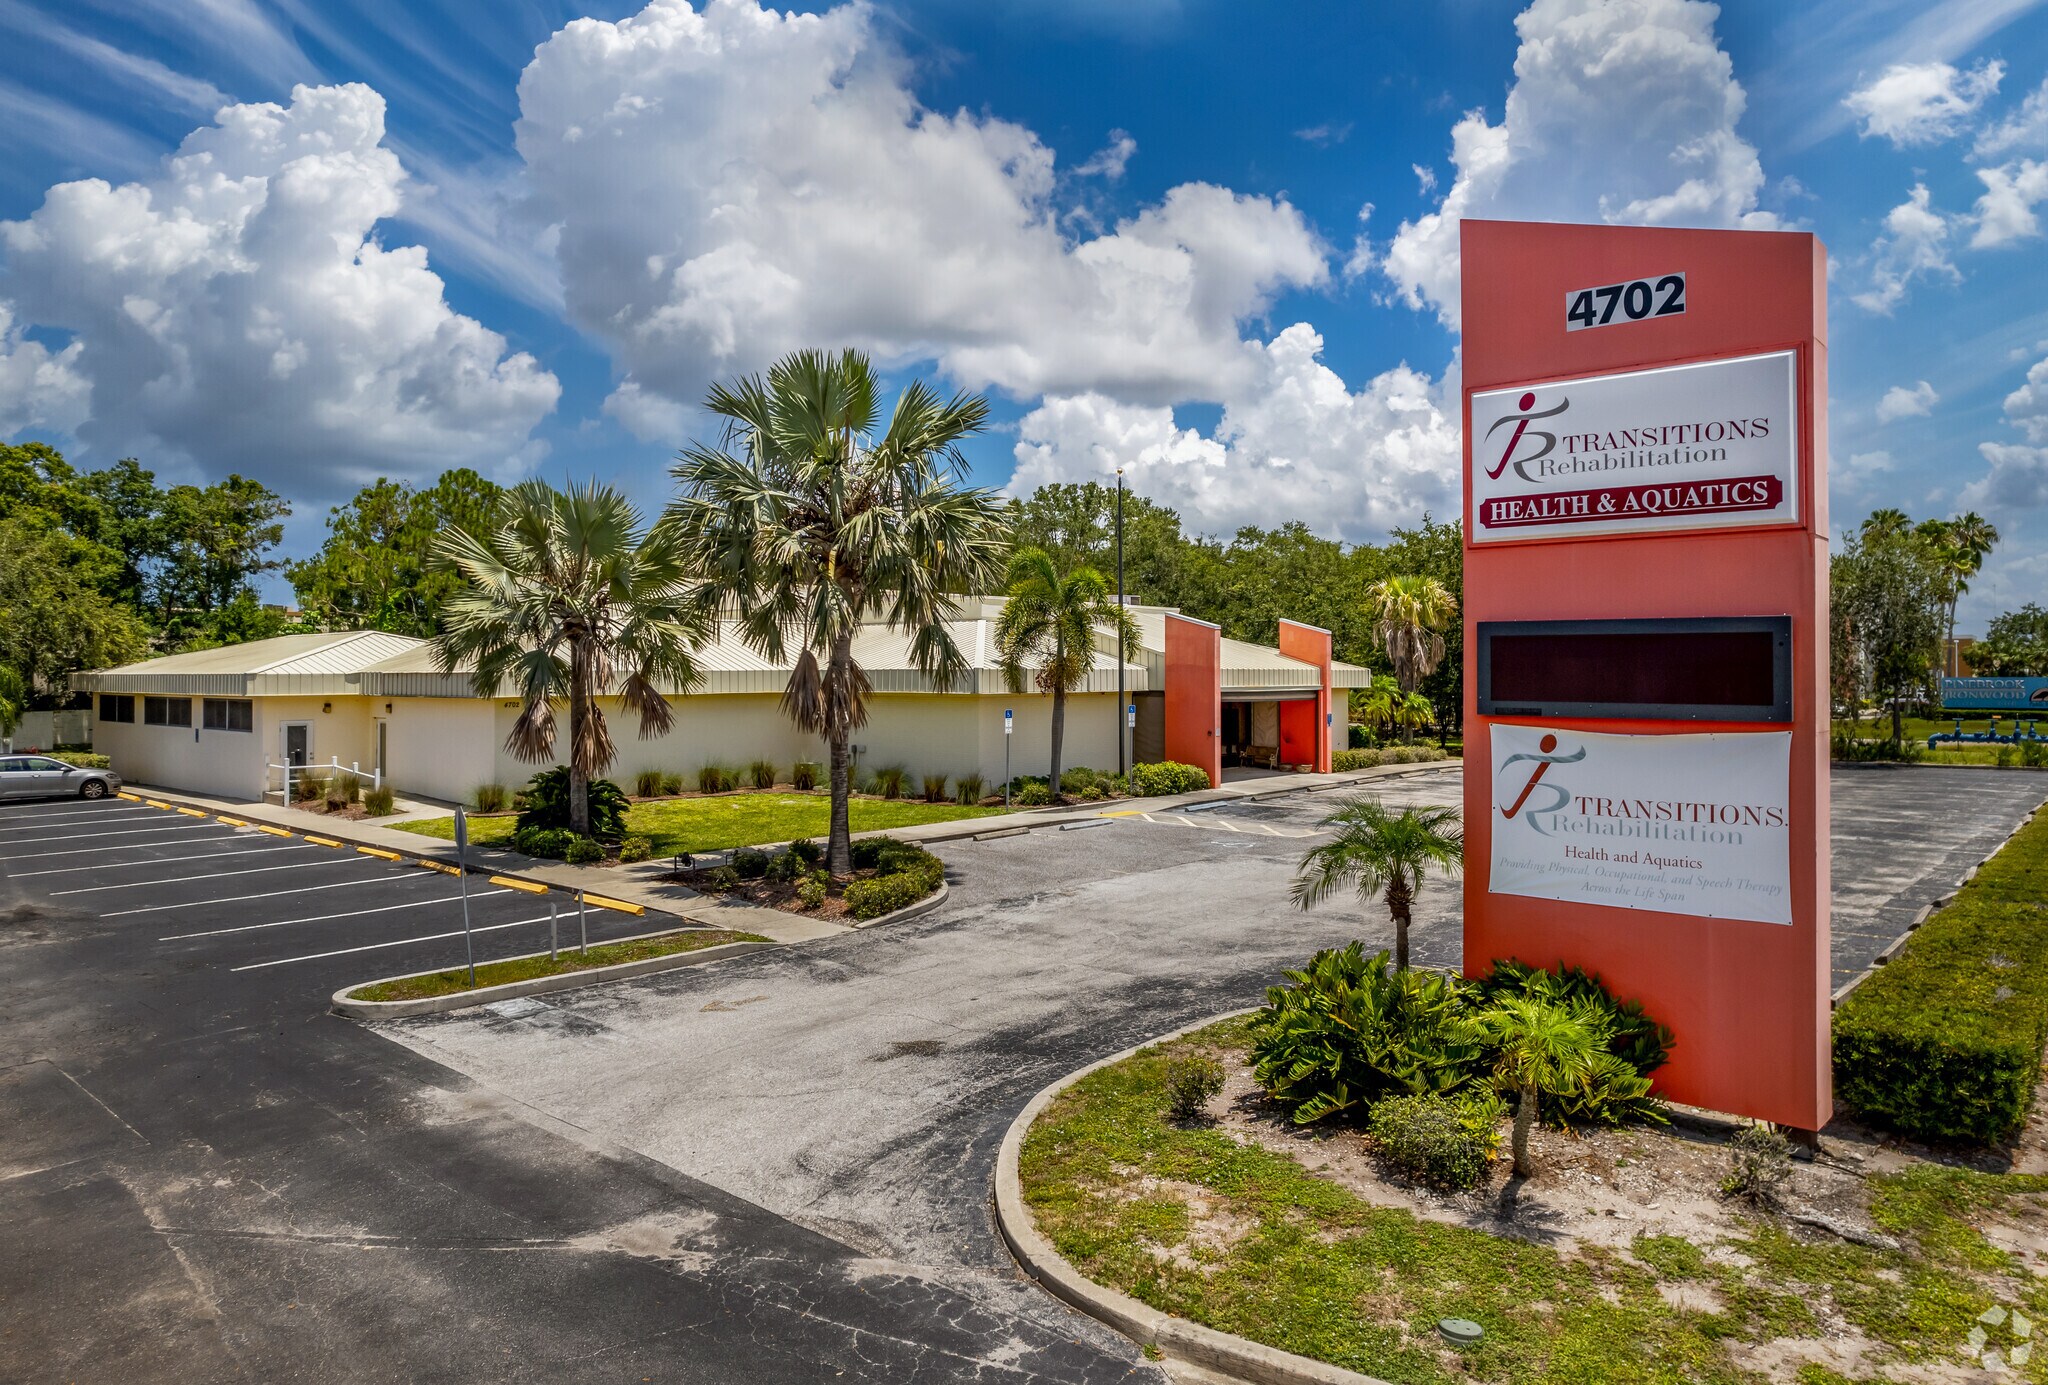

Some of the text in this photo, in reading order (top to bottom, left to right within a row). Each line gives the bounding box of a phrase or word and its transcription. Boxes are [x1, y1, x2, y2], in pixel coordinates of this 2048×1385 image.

[1567, 275, 1685, 327] 4702
[1563, 417, 1770, 455] TRANSITIONS
[1538, 446, 1727, 477] Rehabilitation
[1490, 480, 1768, 521] HEALTH & AQUATICS
[1552, 814, 1743, 845] Rehabilitation
[1564, 845, 1703, 870] Health and Aquatics
[1499, 857, 1545, 874] Providing
[1670, 873, 1693, 886] and
[1696, 875, 1733, 890] Speech
[1736, 879, 1783, 897] Therapy
[1580, 881, 1686, 902] Across the Life Span
